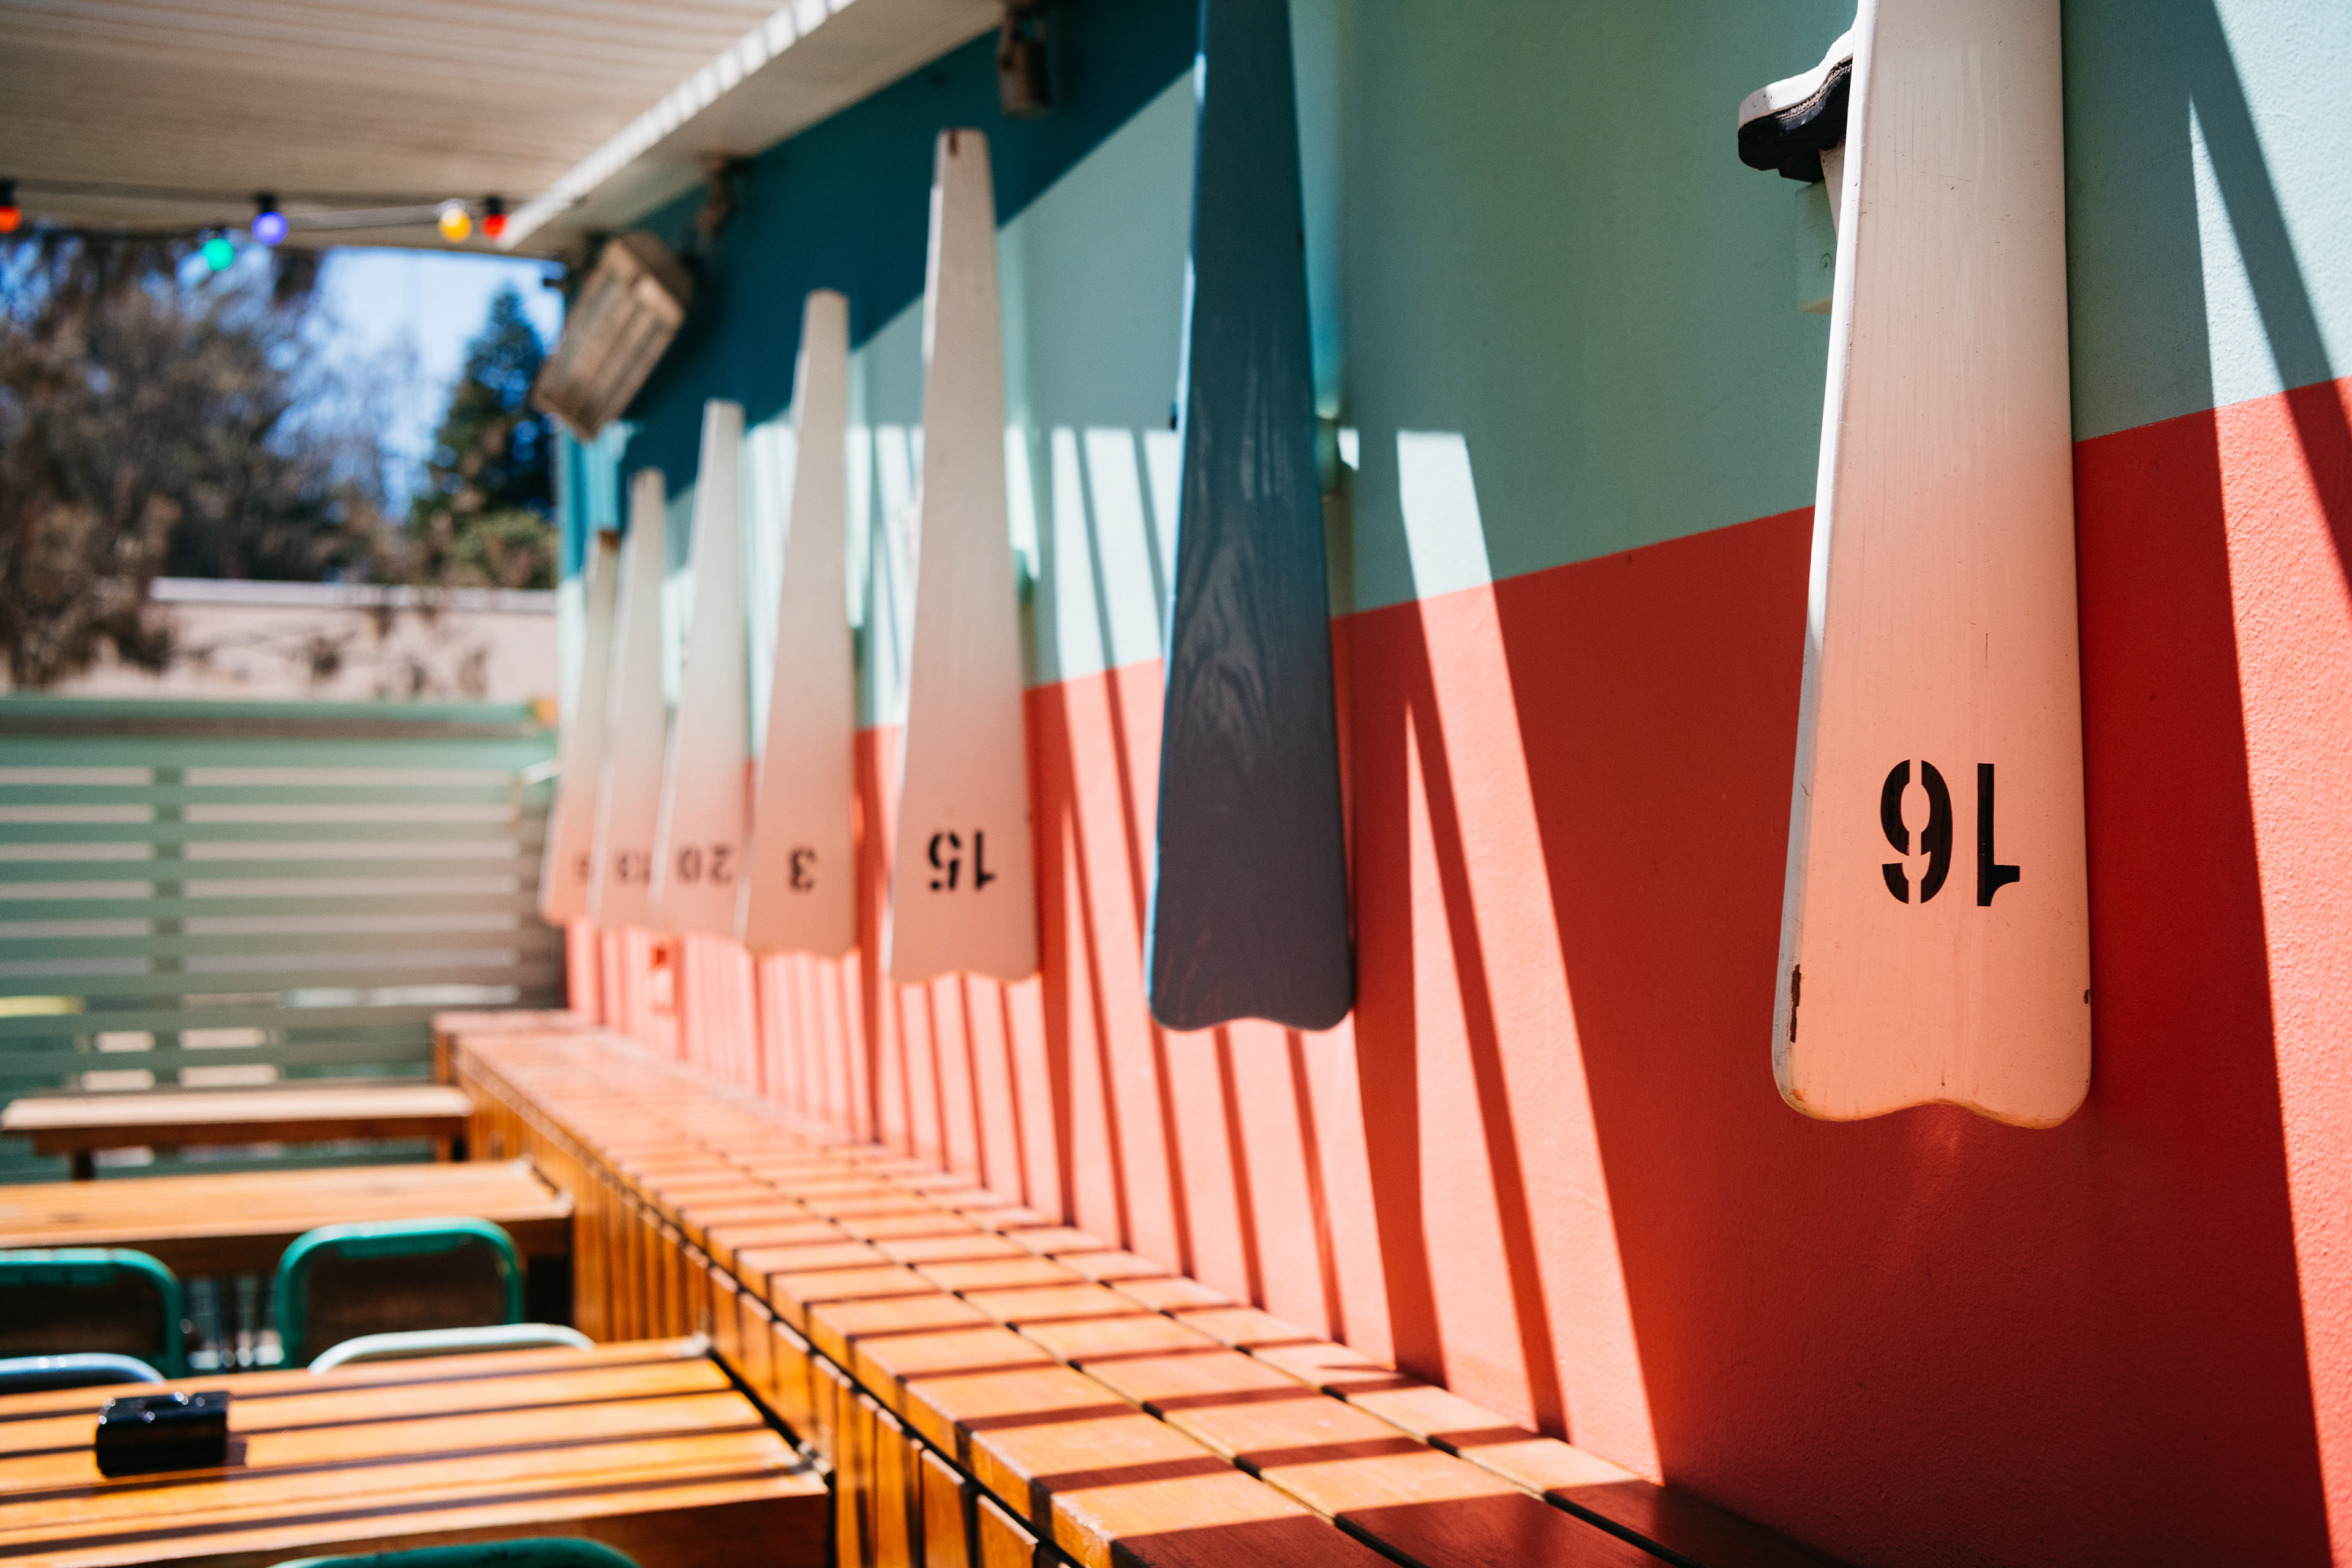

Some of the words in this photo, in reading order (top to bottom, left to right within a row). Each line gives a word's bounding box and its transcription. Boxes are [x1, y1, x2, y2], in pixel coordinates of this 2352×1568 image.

[1880, 759, 2021, 907] 16
[677, 842, 734, 884] 20
[790, 847, 816, 891] 3
[928, 829, 997, 891] 15
